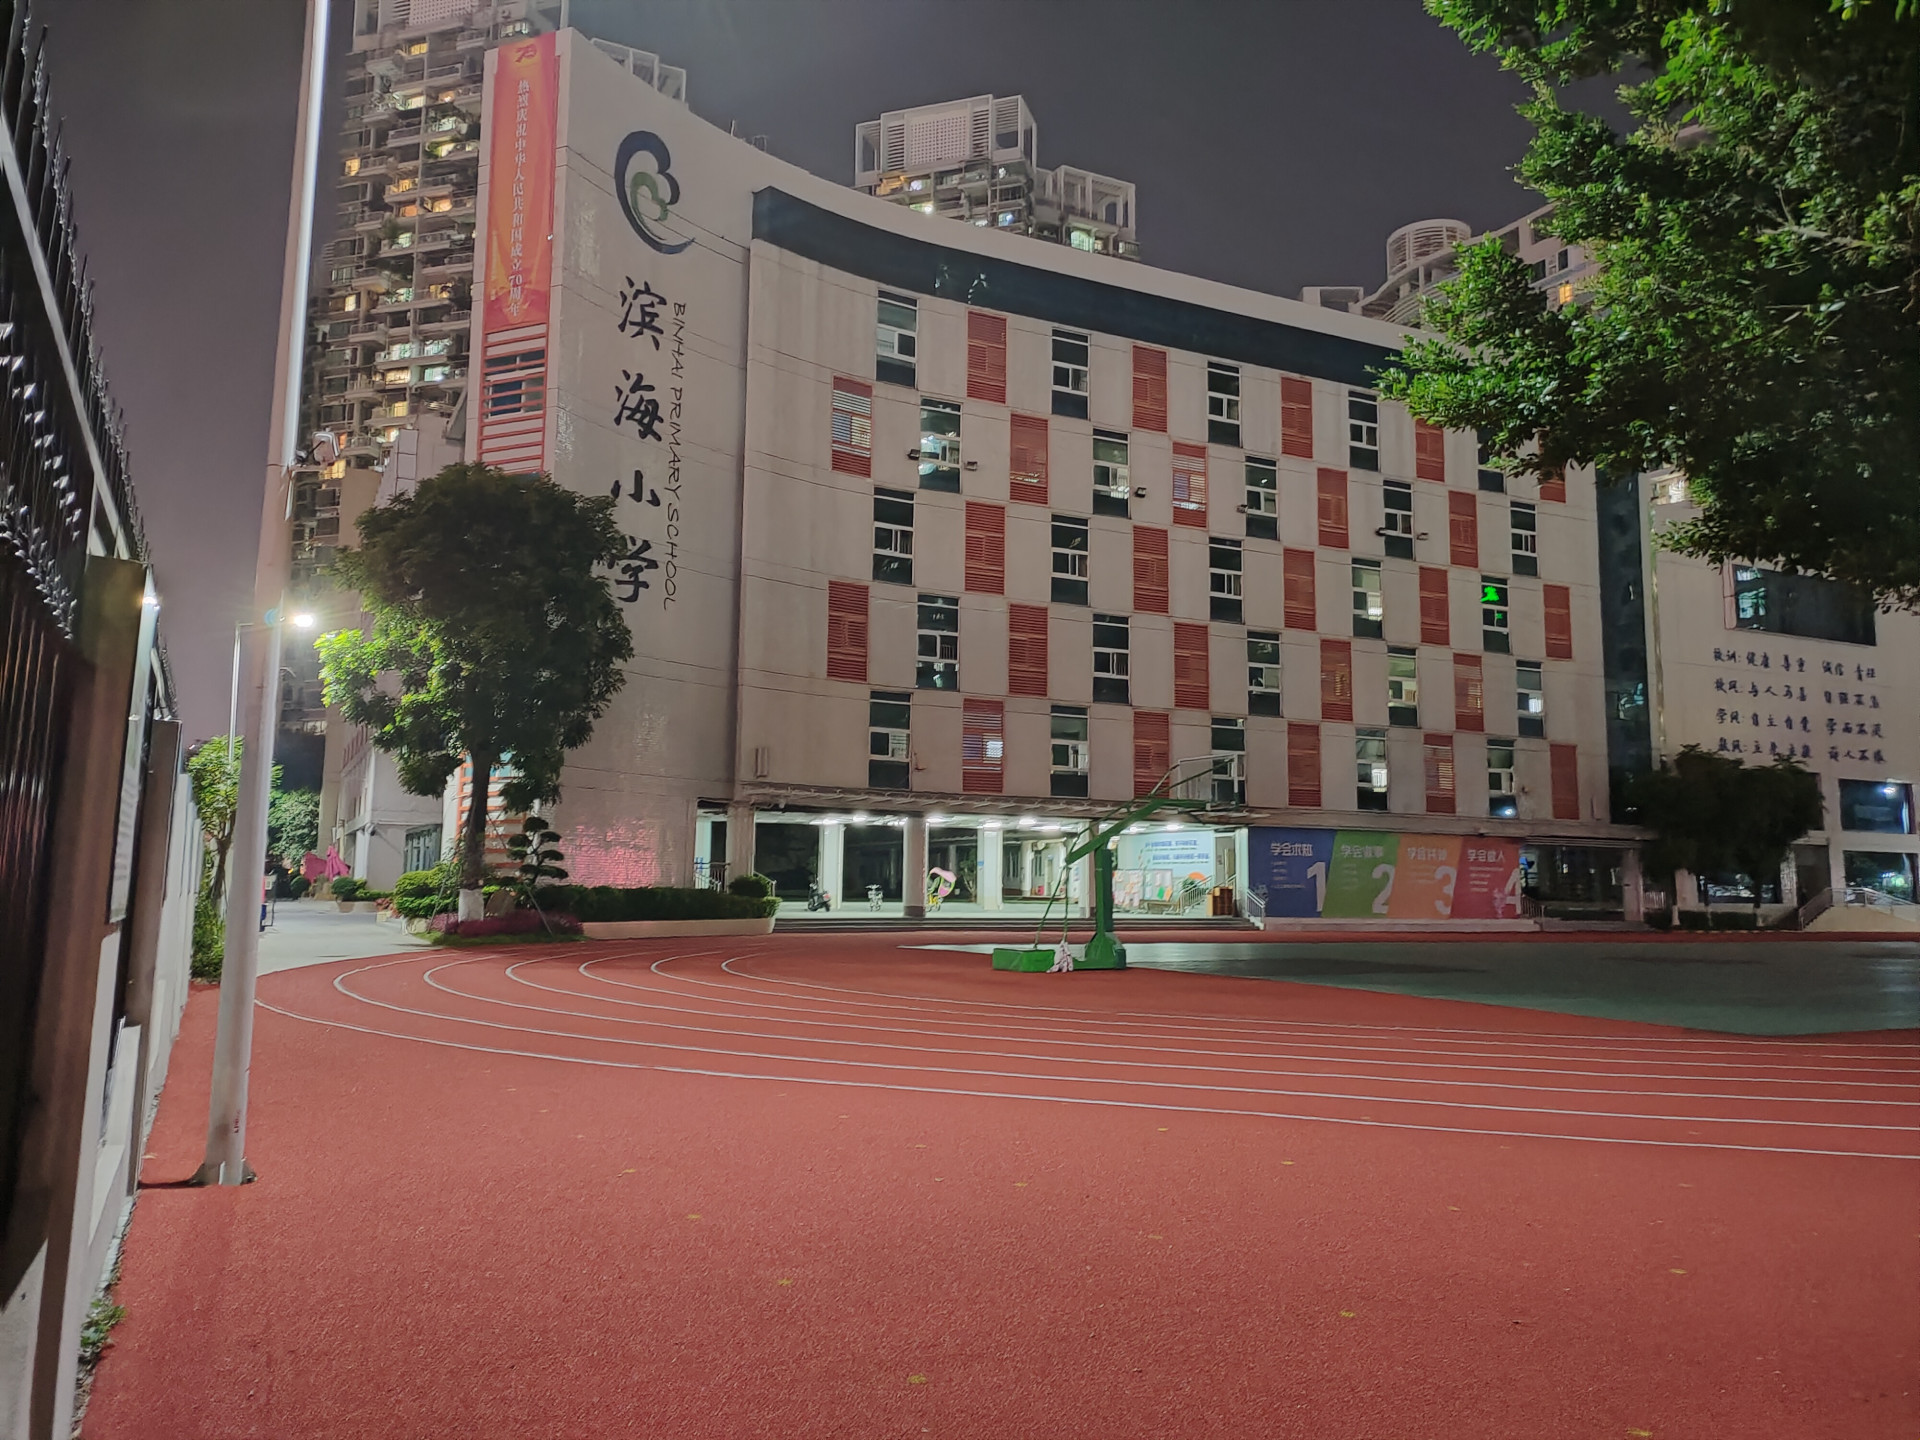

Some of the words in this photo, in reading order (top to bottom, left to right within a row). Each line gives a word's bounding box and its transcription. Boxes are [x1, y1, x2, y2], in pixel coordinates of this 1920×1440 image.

[508, 79, 530, 316] 热烈庆祝中华人民共和国成立70周年
[671, 303, 687, 379] BINHAI
[607, 276, 667, 602] 滨海小学
[664, 387, 683, 500] PRIMARY
[663, 503, 680, 610] SCHOOL
[1270, 842, 1313, 857] 学会求知
[1307, 861, 1327, 912] 1
[1372, 864, 1396, 914] 2
[1434, 866, 1457, 915] 3
[1504, 868, 1522, 914] 4
